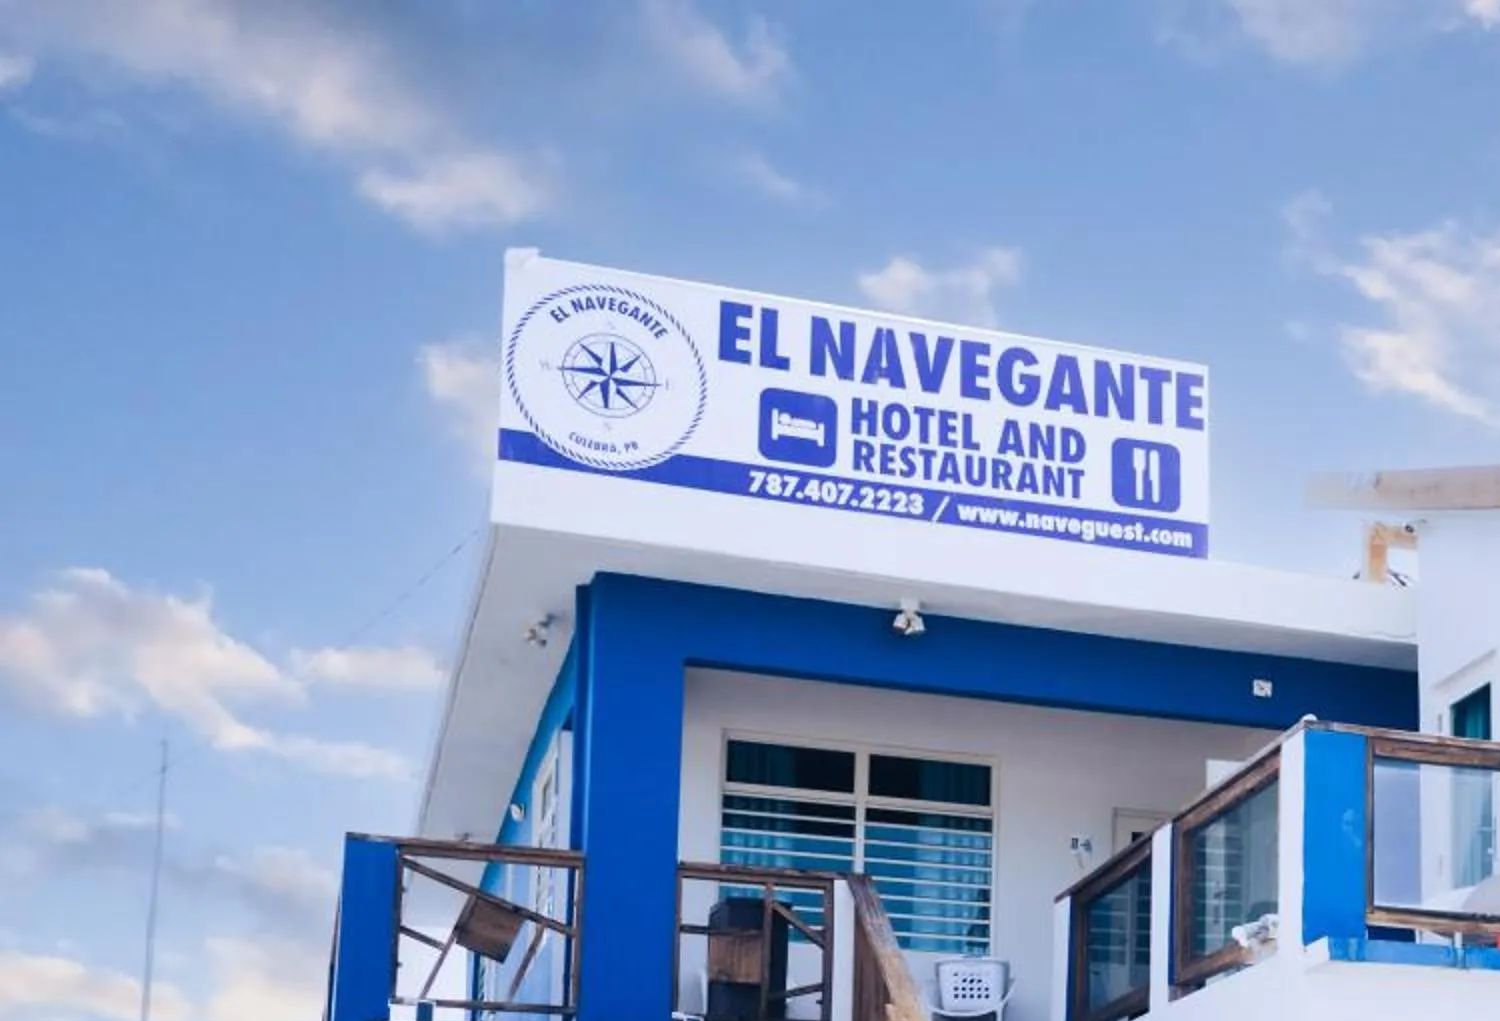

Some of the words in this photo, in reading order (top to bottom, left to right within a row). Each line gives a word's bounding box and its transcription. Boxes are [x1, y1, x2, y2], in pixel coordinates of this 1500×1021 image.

[550, 305, 571, 323] EL
[571, 296, 669, 339] NAVEGANTE
[718, 300, 791, 371] EL
[809, 315, 1205, 432] NAVEGANTE
[851, 397, 981, 451] HOTEL
[997, 418, 1087, 464] AND
[852, 439, 1085, 499] RESTAURANT
[748, 470, 924, 515] 787.407.2223
[957, 503, 1193, 548] www.naveguest.com
